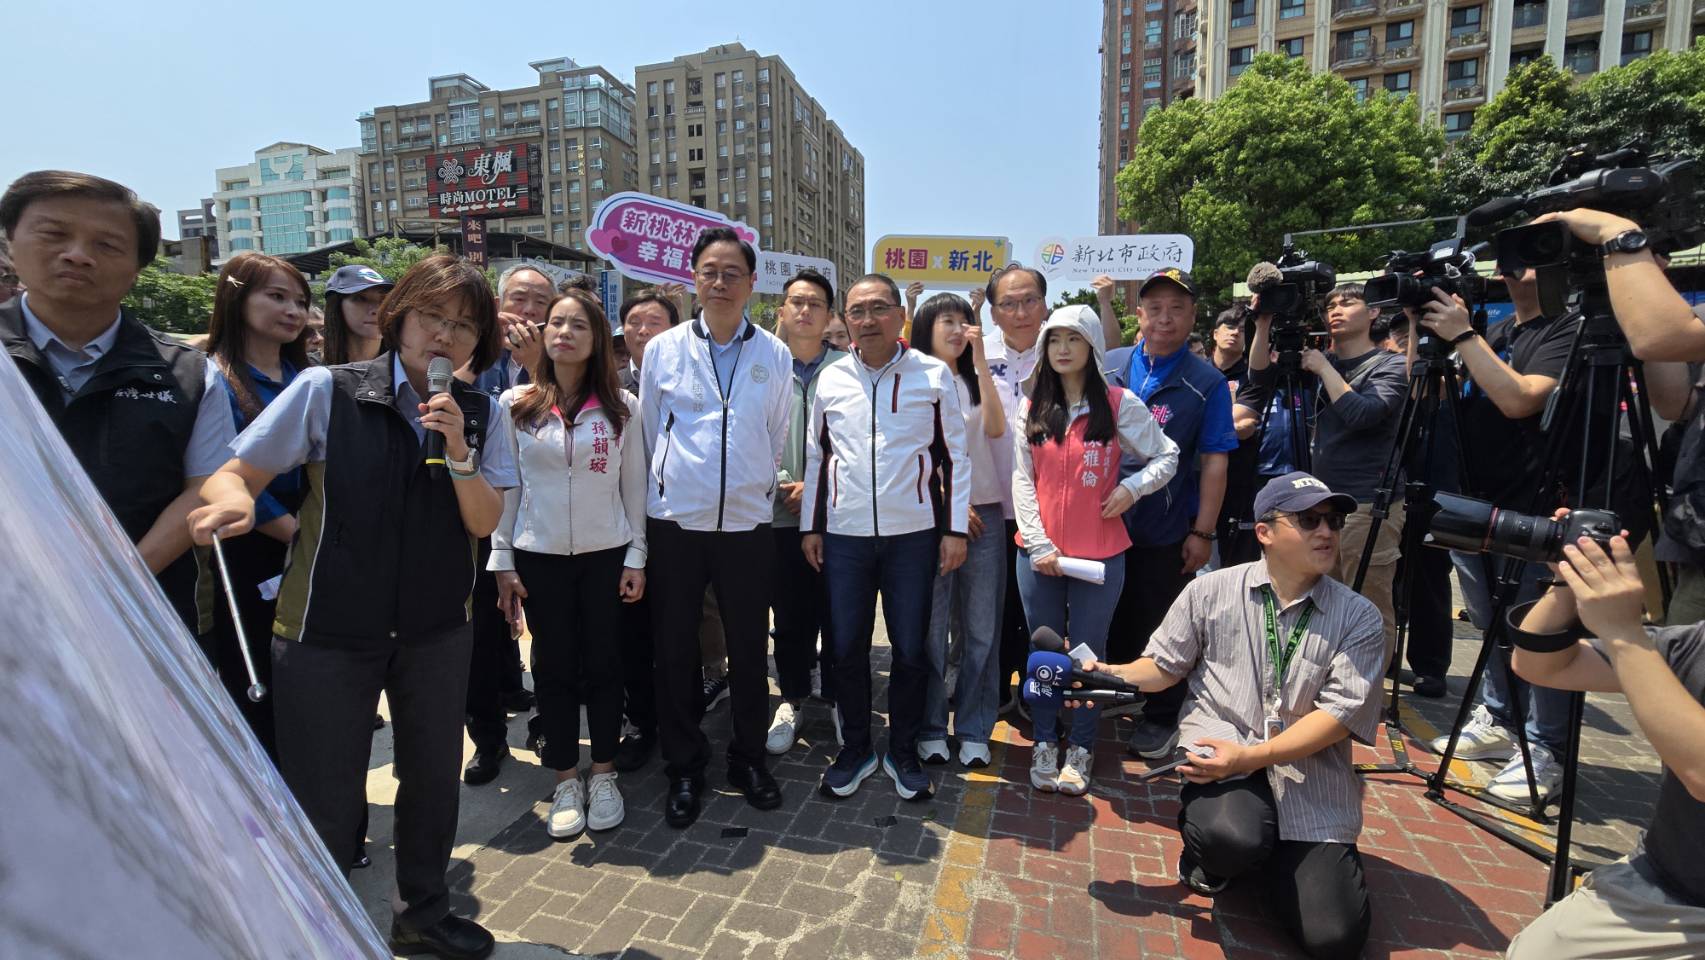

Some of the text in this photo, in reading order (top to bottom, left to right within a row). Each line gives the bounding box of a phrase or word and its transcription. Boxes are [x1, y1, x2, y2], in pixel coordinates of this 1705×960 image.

[468, 150, 513, 185] 東楓
[621, 208, 704, 247] 新桃林
[638, 241, 694, 271] 幸福
[885, 248, 928, 269] 桃園
[948, 249, 993, 272] 新北
[1072, 242, 1183, 266] 新北市政府
[1052, 665, 1064, 686] FTV
